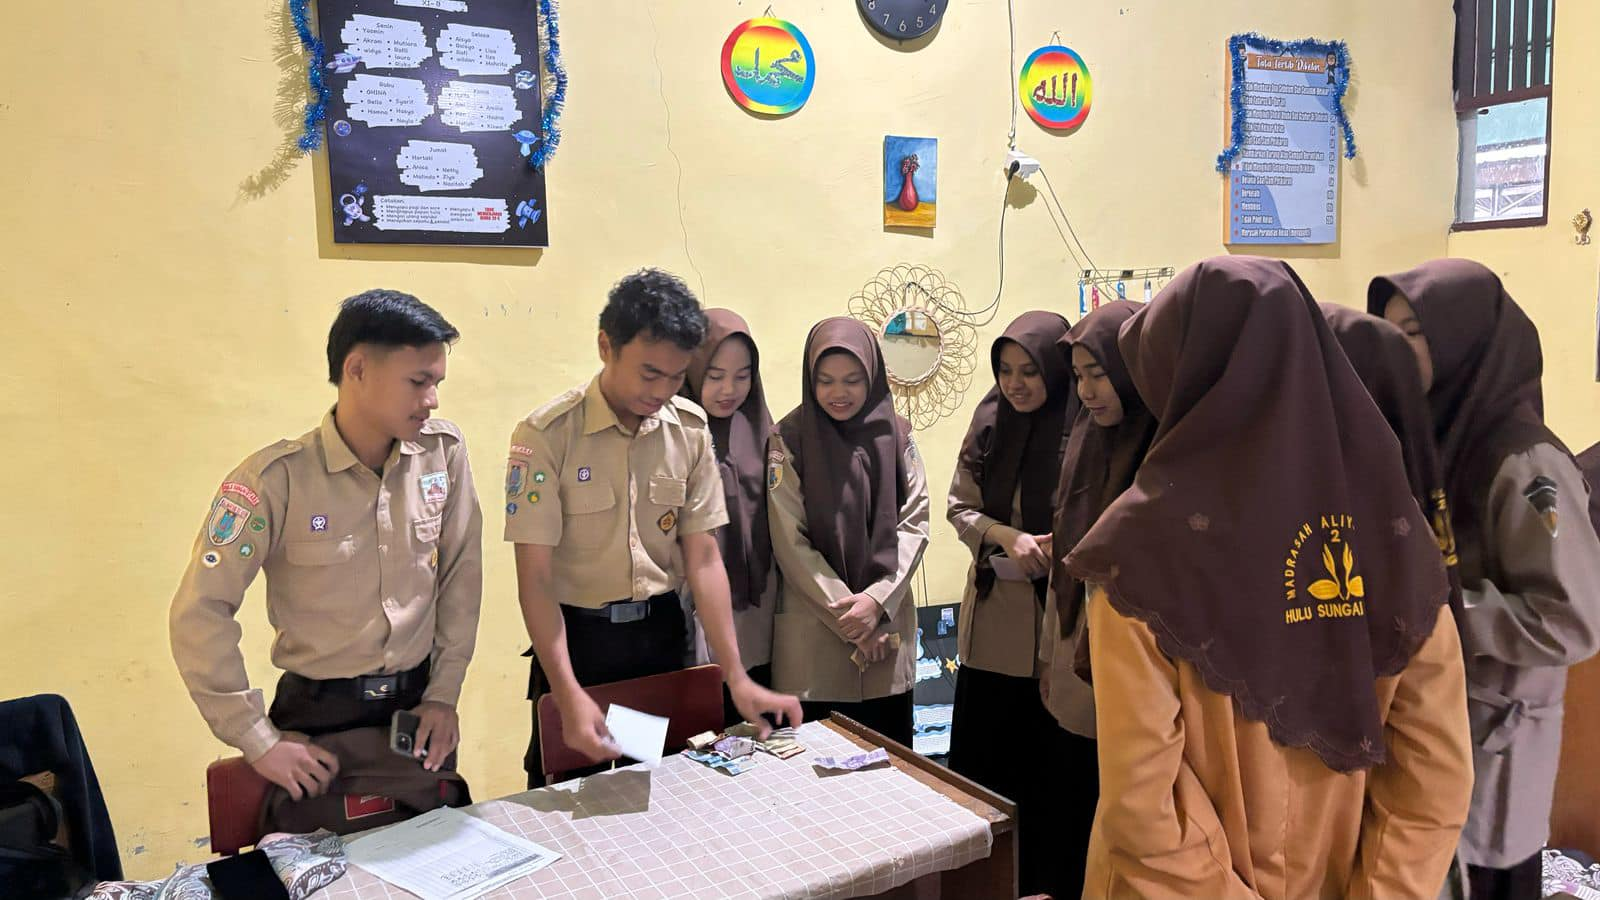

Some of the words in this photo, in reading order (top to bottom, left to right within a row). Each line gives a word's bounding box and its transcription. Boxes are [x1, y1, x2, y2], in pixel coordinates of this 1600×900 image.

[929, 4, 937, 15] 4
[883, 13, 890, 25] 7
[916, 16, 924, 28] 5
[899, 20, 907, 32] 6
[1256, 55, 1272, 68] Tata
[1032, 71, 1078, 108] الله
[1331, 529, 1341, 542] 2
[1285, 523, 1312, 600] MADRASAH
[1321, 514, 1355, 530] ALIY
[1285, 606, 1312, 624] HULU
[1317, 601, 1364, 617] SUNGAI
